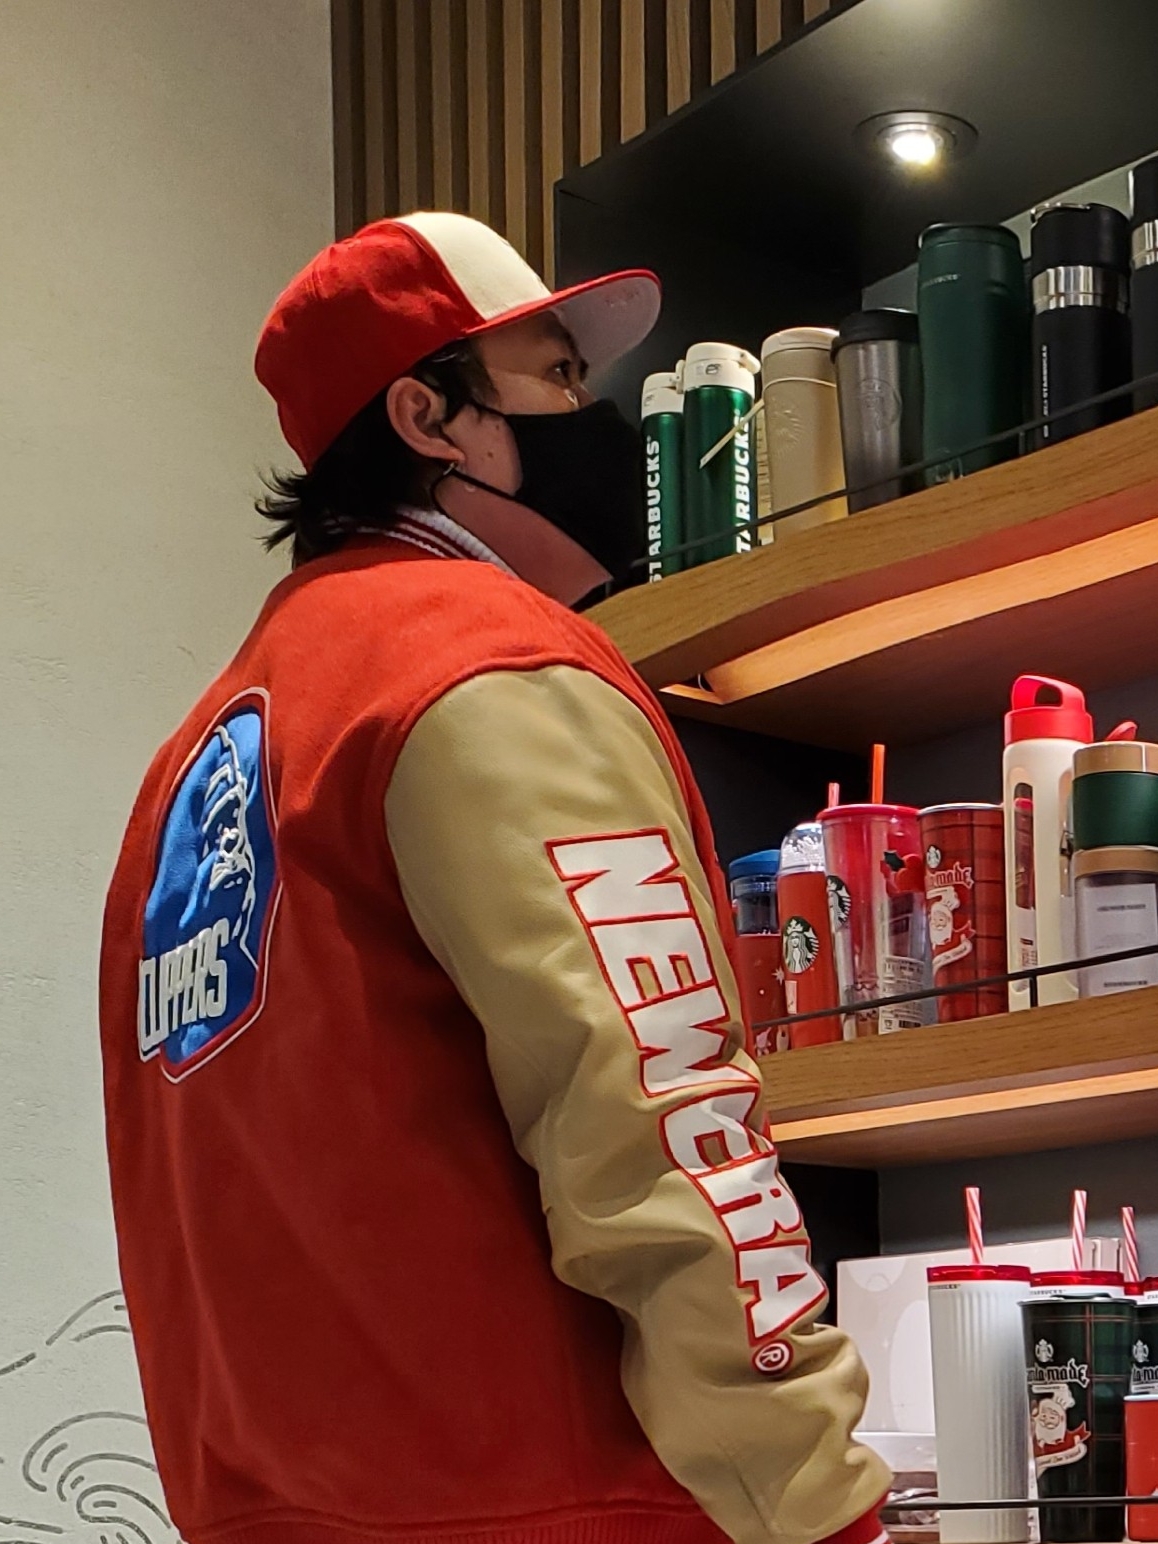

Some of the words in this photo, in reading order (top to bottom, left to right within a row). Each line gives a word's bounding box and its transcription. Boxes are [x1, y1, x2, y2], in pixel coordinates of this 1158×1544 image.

[646, 438, 663, 583] STARBUCKS
[137, 917, 230, 1060] CLIPPERS
[544, 826, 763, 1099] NEW
[659, 1078, 830, 1346] ERA
